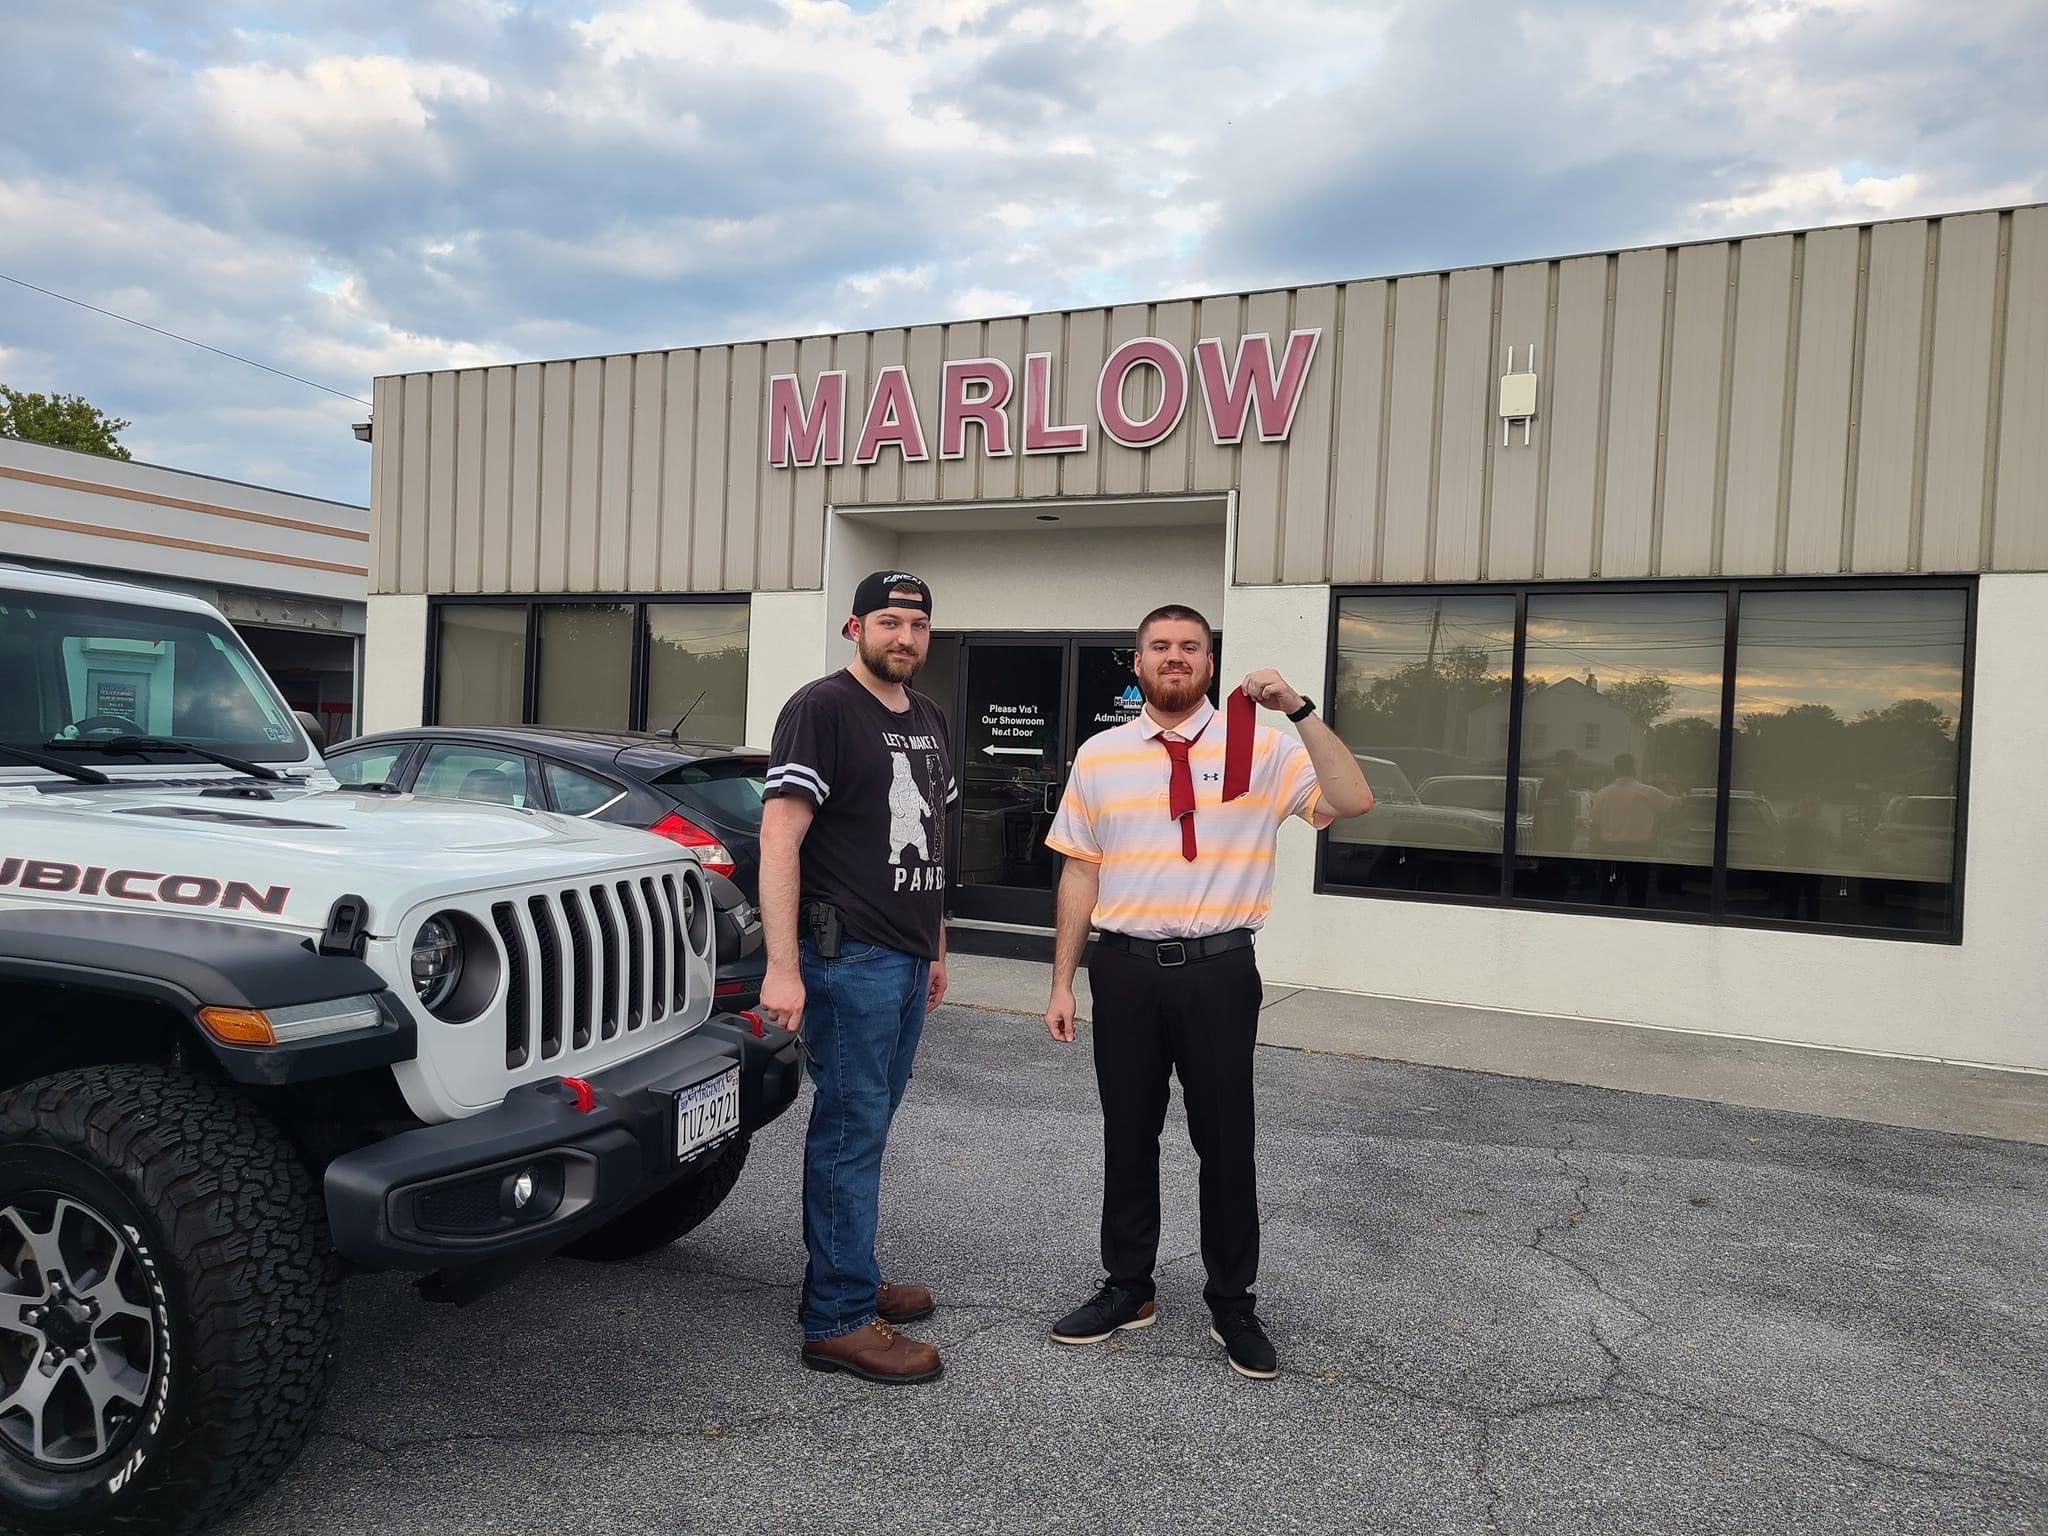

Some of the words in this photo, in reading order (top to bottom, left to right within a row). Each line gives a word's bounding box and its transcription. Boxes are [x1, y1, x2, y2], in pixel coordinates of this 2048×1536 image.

[768, 327, 1322, 469] MARLOW
[982, 715, 998, 724] Our
[999, 715, 1045, 725] Showroom
[989, 704, 1017, 713] Please
[1094, 712, 1138, 722] Administ
[881, 731, 909, 749] LET'S
[908, 735, 934, 750] MAKE
[991, 727, 1011, 736] Next
[1012, 727, 1034, 737] Door
[893, 866, 945, 891] PAND
[694, 1078, 726, 1102] VIRGINIA
[681, 1088, 738, 1146] TUZ-9721
[122, 1223, 171, 1435] All-Terrain
[108, 1447, 147, 1495] T/A
